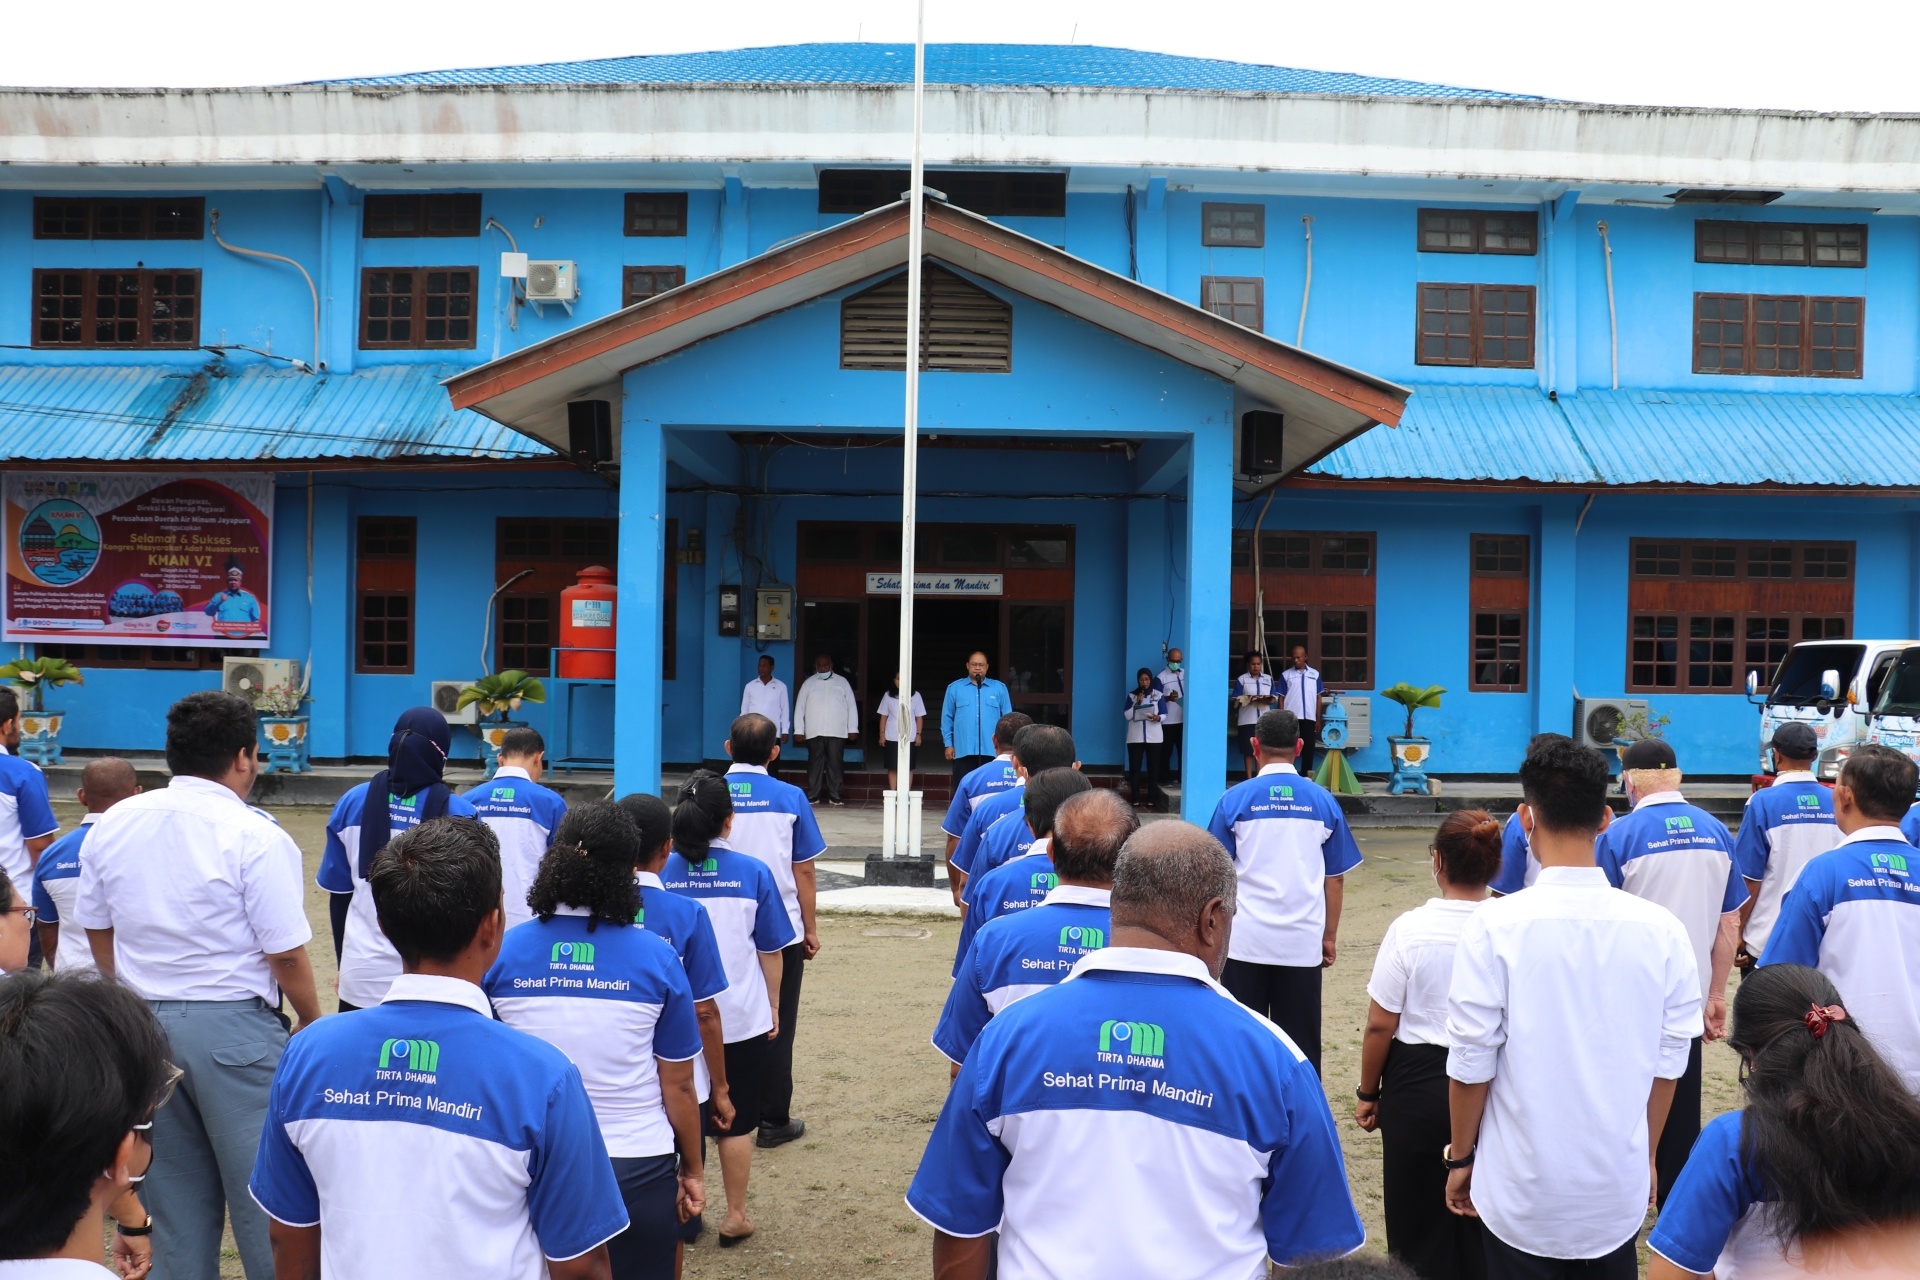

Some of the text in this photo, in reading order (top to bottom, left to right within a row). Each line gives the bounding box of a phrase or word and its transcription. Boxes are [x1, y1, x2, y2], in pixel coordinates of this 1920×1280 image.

[50, 511, 75, 519] KMAN
[218, 516, 250, 525] Jayapura
[130, 533, 232, 544] Selamat & Sukses
[103, 543, 134, 552] Kongres
[136, 544, 182, 552] Masyarakat
[148, 555, 212, 566] KMAN VI
[914, 580, 932, 589] rima
[935, 580, 950, 589] dan
[954, 578, 990, 590] Mandiri
[509, 805, 532, 813] Mandiri
[1290, 804, 1312, 812] Mandiri
[1647, 840, 1670, 849] Sehat
[1692, 836, 1716, 844] Mandiri
[1890, 869, 1910, 877] DHARMA
[1848, 878, 1876, 887] Sehat
[1878, 878, 1902, 889] Prima
[1003, 900, 1028, 910] Sehat
[1058, 946, 1076, 954] TIRTA
[1022, 958, 1055, 970] Sehat
[514, 977, 630, 991] Sehat Prima Mandiri
[1096, 1051, 1165, 1069] TIRTA DHARMA
[376, 1070, 436, 1085] TIRTA DHARMA
[1043, 1072, 1213, 1108] Sehat Prima Mandiri
[324, 1088, 483, 1121] Sehat Prima Mandiri
